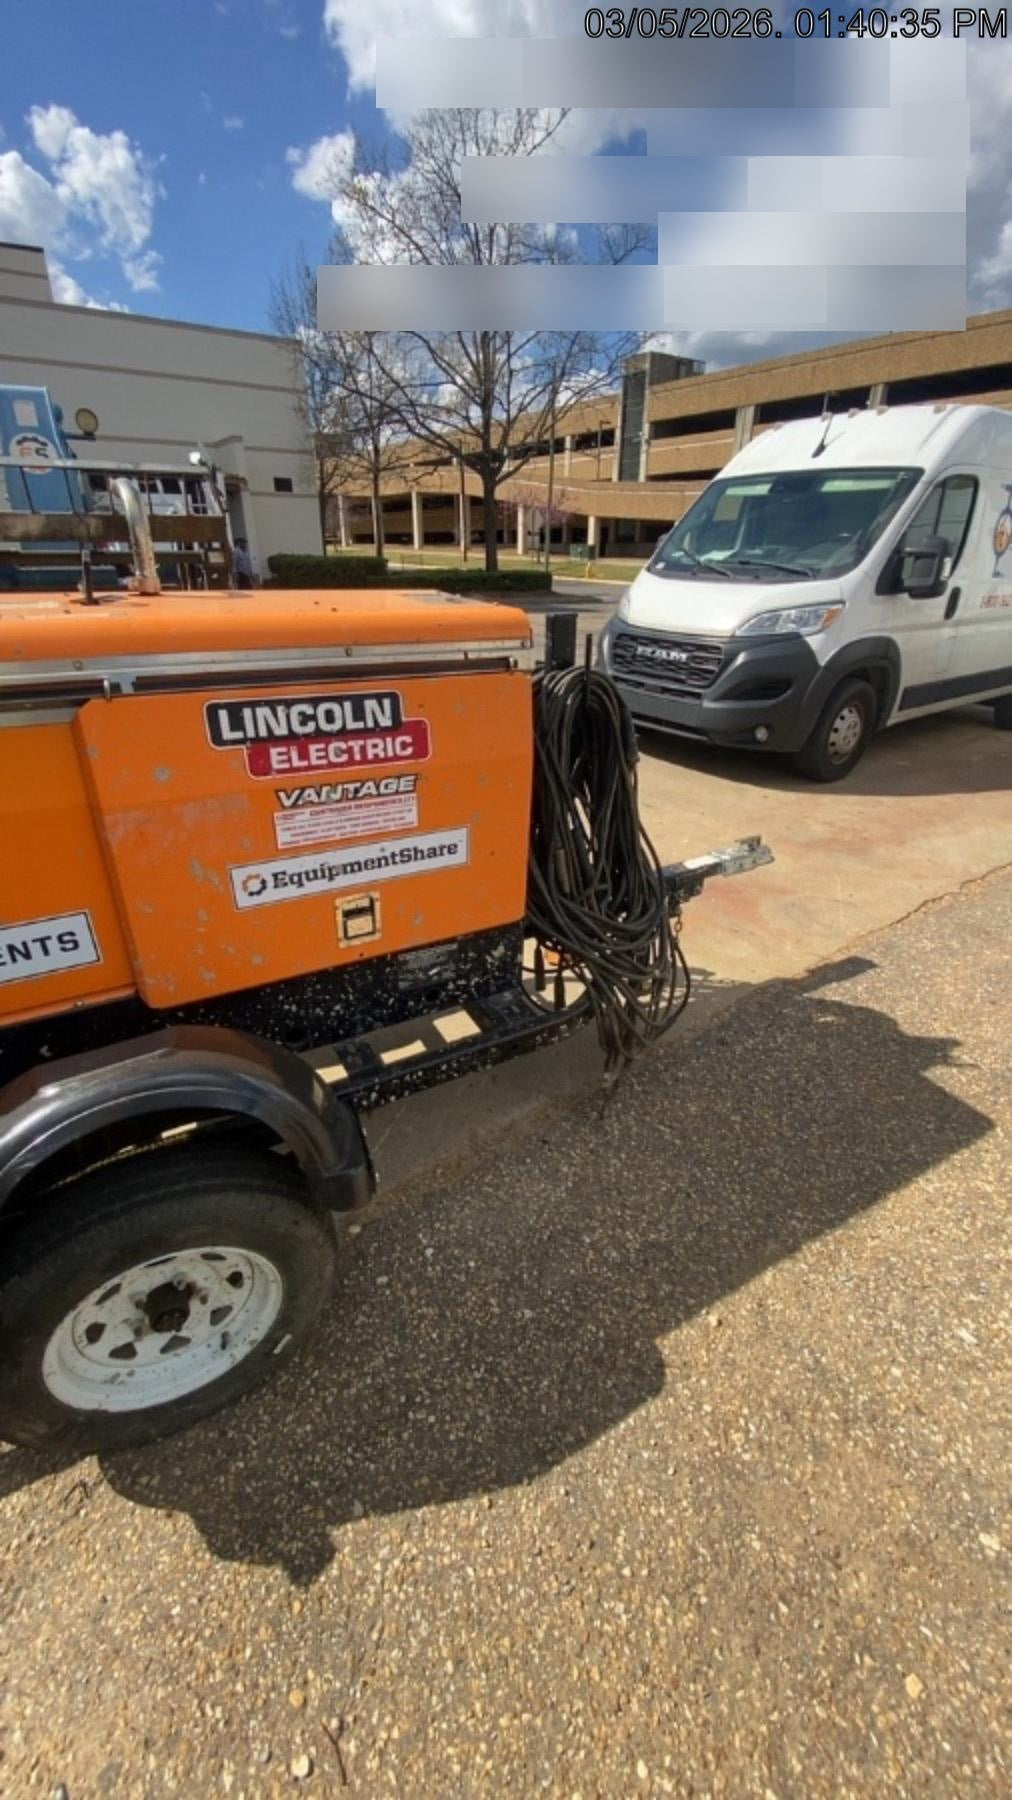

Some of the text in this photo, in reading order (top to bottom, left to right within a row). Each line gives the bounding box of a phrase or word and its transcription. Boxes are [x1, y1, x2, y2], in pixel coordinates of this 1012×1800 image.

[635, 645, 689, 662] RAM
[217, 697, 392, 741] LINCOLN
[269, 735, 415, 770] ELECTRIC
[276, 775, 417, 808] VANTAGE
[271, 841, 459, 890] EquipmentShare
